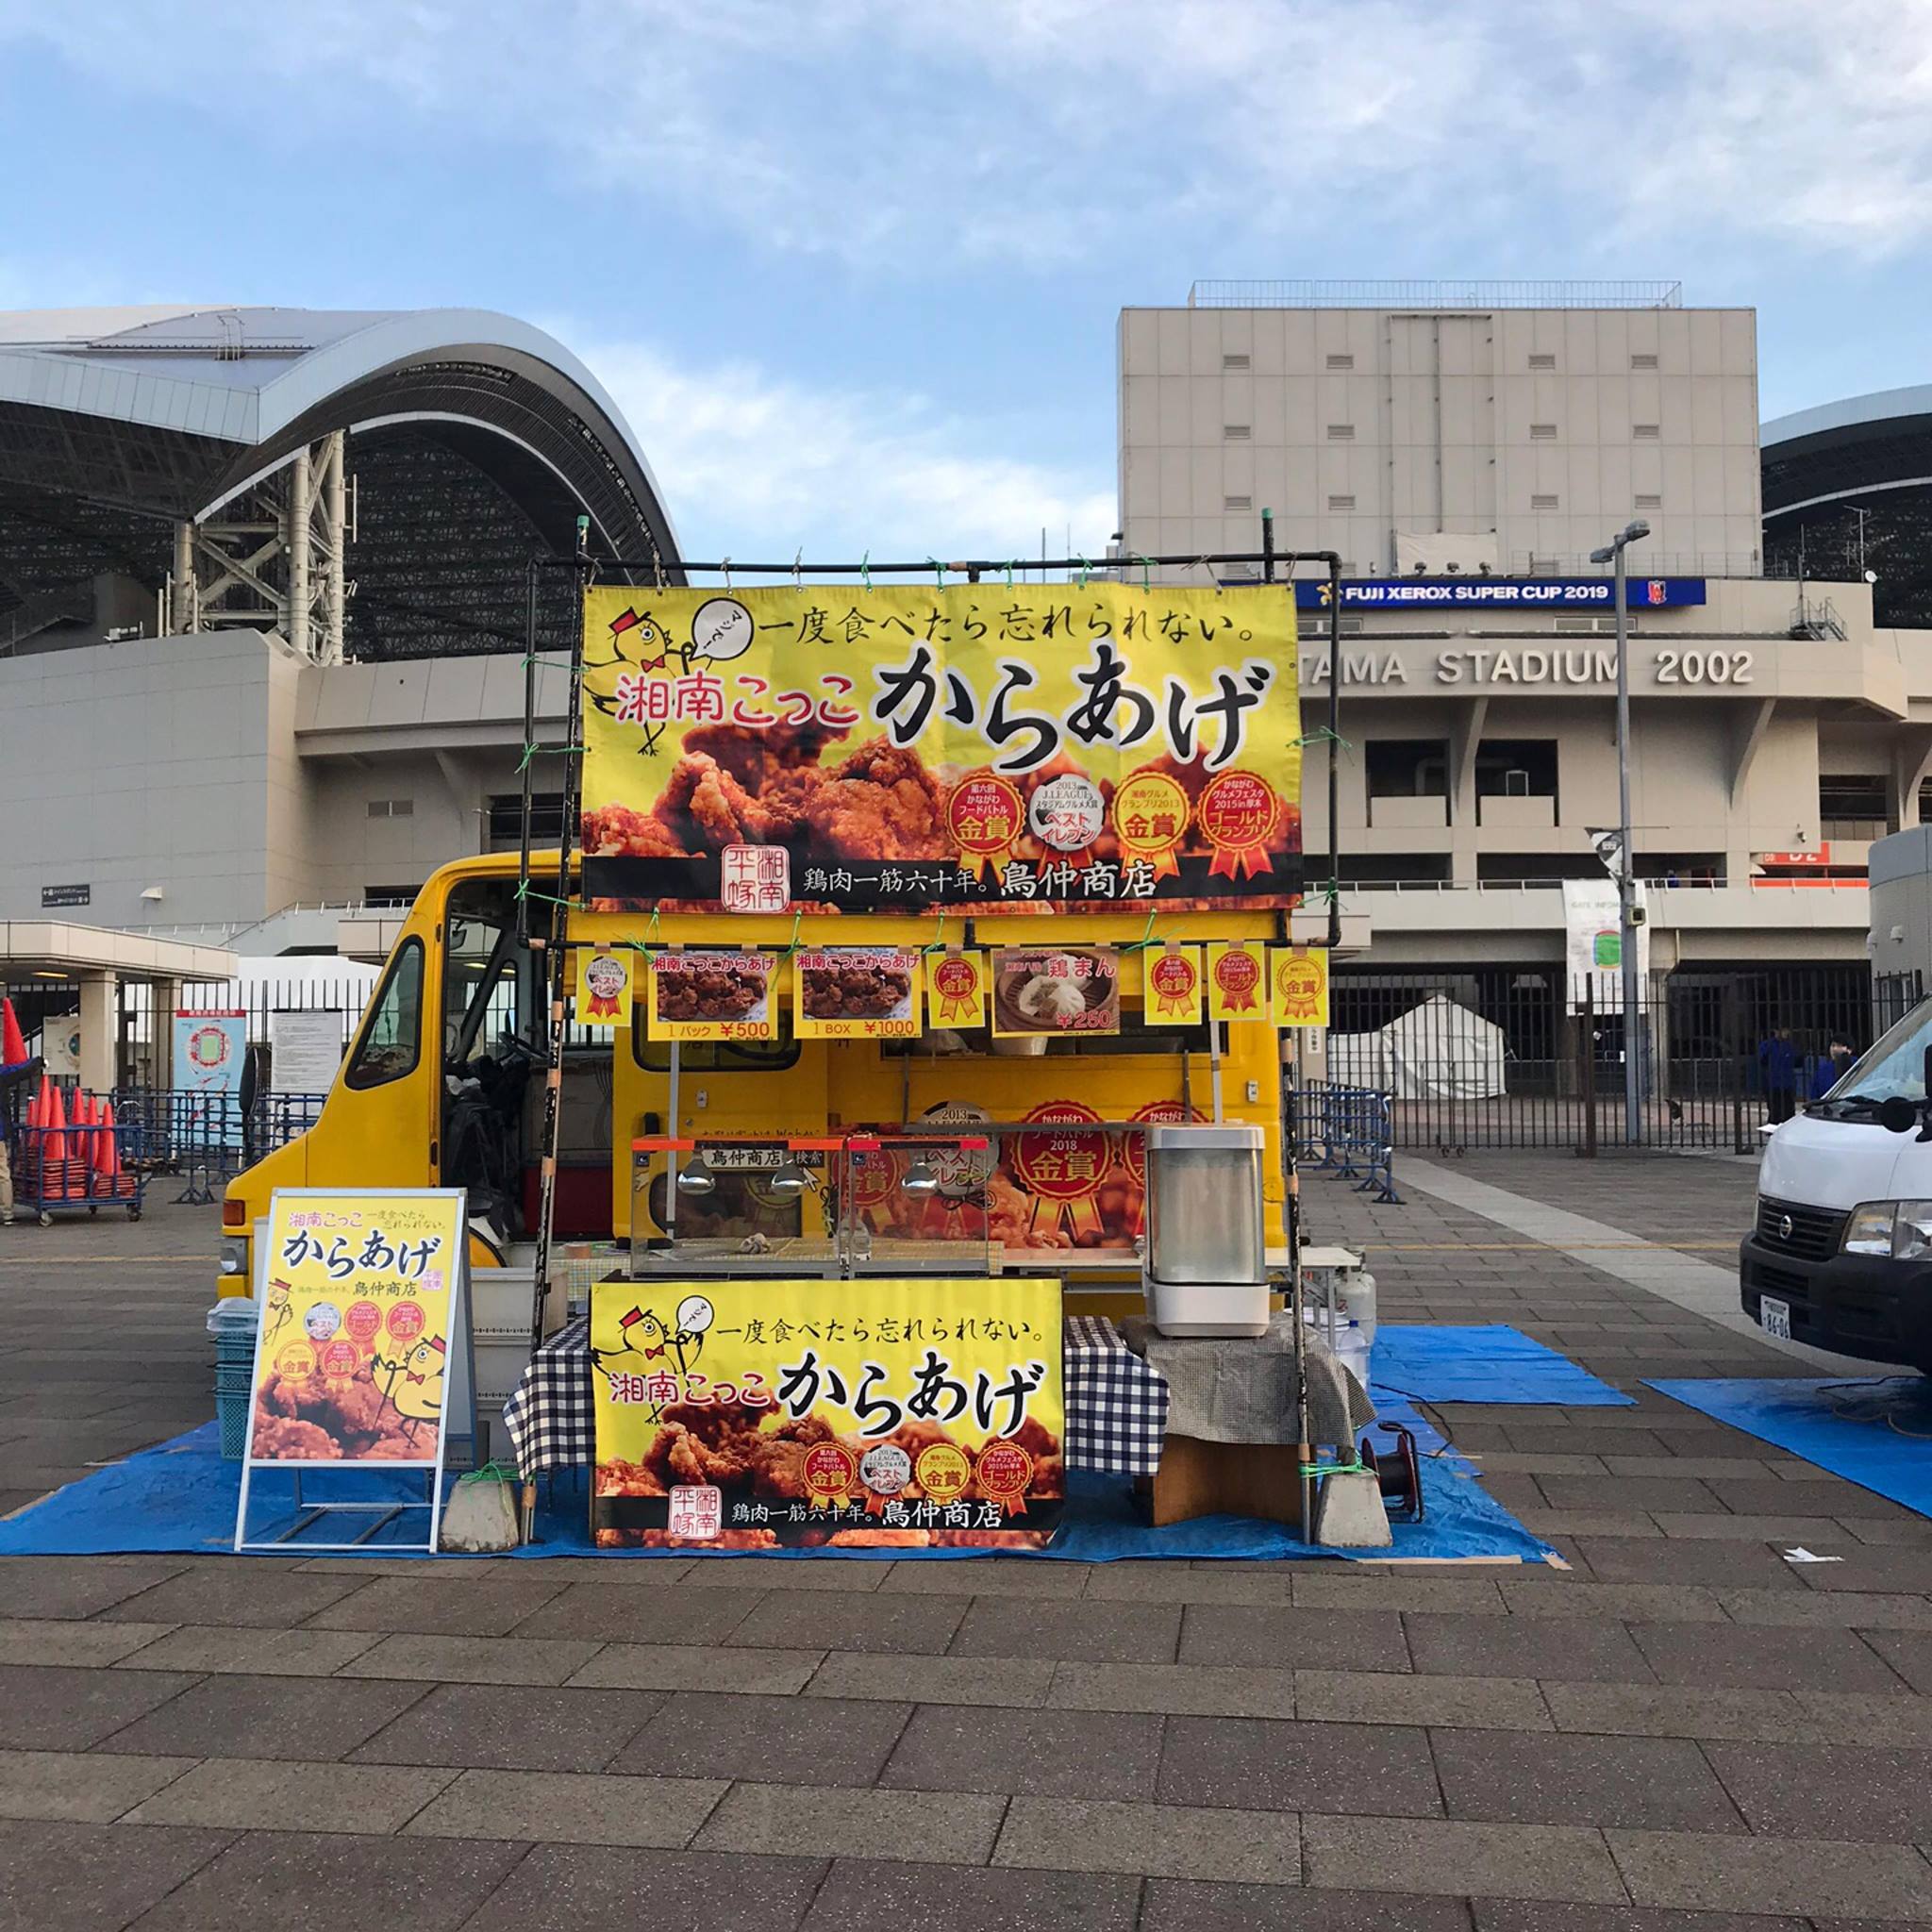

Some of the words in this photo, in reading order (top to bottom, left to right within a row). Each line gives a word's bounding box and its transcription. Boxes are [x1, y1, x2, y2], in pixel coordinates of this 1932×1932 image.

[1345, 587, 1384, 600] FUJI
[1387, 586, 1452, 600] XEROX
[1455, 586, 1519, 599] SUPER
[1522, 586, 1562, 599] CUP
[1564, 586, 1608, 599] 2019
[758, 603, 1253, 645] 一度食べたら忘れられない。
[1298, 651, 1407, 684] TAMA
[1437, 650, 1619, 683] STADIUM
[1657, 649, 1754, 683] 2002
[617, 671, 860, 725] 湘南こっこ
[875, 644, 1271, 770] からあげ
[1056, 781, 1077, 791] 2013
[1212, 790, 1265, 800] グルメフェスタ
[958, 805, 1008, 815] フードバトル
[1208, 809, 1268, 825] ゴールド
[1044, 811, 1091, 827] ベスト
[1124, 813, 1177, 839] 金賞
[958, 815, 1010, 841] 金賞
[1041, 827, 1096, 844] イレブン
[1209, 824, 1267, 839] グランプリ
[1000, 859, 1157, 899] 鳥仲商店
[651, 956, 776, 973] 湘南こっこからあげ
[796, 954, 922, 970] 湘南こっこからあげ
[1048, 957, 1117, 979] 鶏まん
[680, 1025, 711, 1038] パック
[824, 1024, 852, 1035] BOX
[941, 1108, 968, 1121] 2013
[1050, 1140, 1077, 1151] 2018
[1029, 1150, 1097, 1182] 金賞
[283, 1229, 441, 1278] からあげ
[716, 1317, 1042, 1345] 一度食べたら忘れられない。
[609, 1370, 771, 1406] 湘南こっこ
[778, 1351, 1045, 1437] からあげ
[811, 1471, 847, 1488] 金賞
[925, 1470, 962, 1488] 金賞
[984, 1470, 1026, 1481] ゴールド
[882, 1499, 1002, 1528] 鳥仲商店
